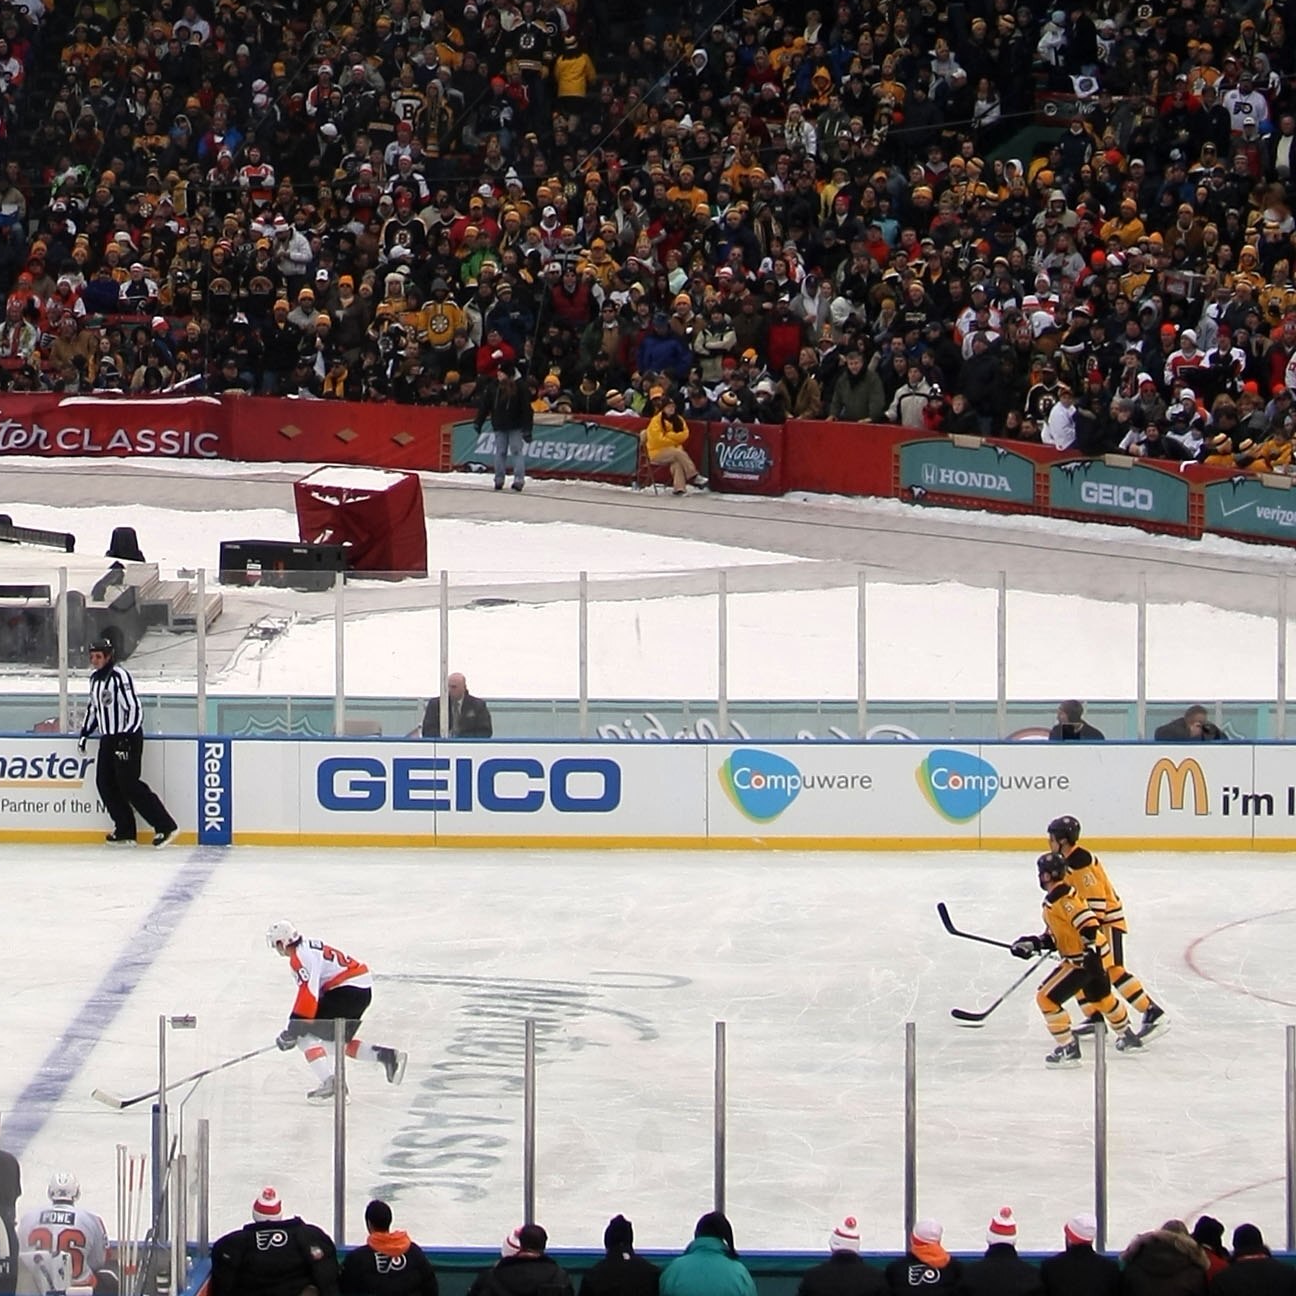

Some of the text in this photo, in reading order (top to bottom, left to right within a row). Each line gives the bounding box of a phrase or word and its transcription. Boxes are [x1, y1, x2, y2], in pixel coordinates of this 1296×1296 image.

[56, 428, 220, 458] CLASSIC
[474, 432, 616, 463] BGESTONE
[716, 442, 768, 468] Winter
[726, 459, 766, 471] CLASSIC
[940, 468, 1012, 492] HONDA
[1080, 481, 1153, 511] GEICO
[204, 742, 224, 832] Reebok
[317, 757, 622, 813] GEICO
[733, 767, 872, 796] Compuware
[930, 767, 1069, 796] Compuware
[1, 798, 50, 814] Partner
[53, 798, 67, 814] of
[70, 798, 92, 814] the
[1222, 786, 1273, 816] i'm
[42, 1212, 72, 1224] POWE
